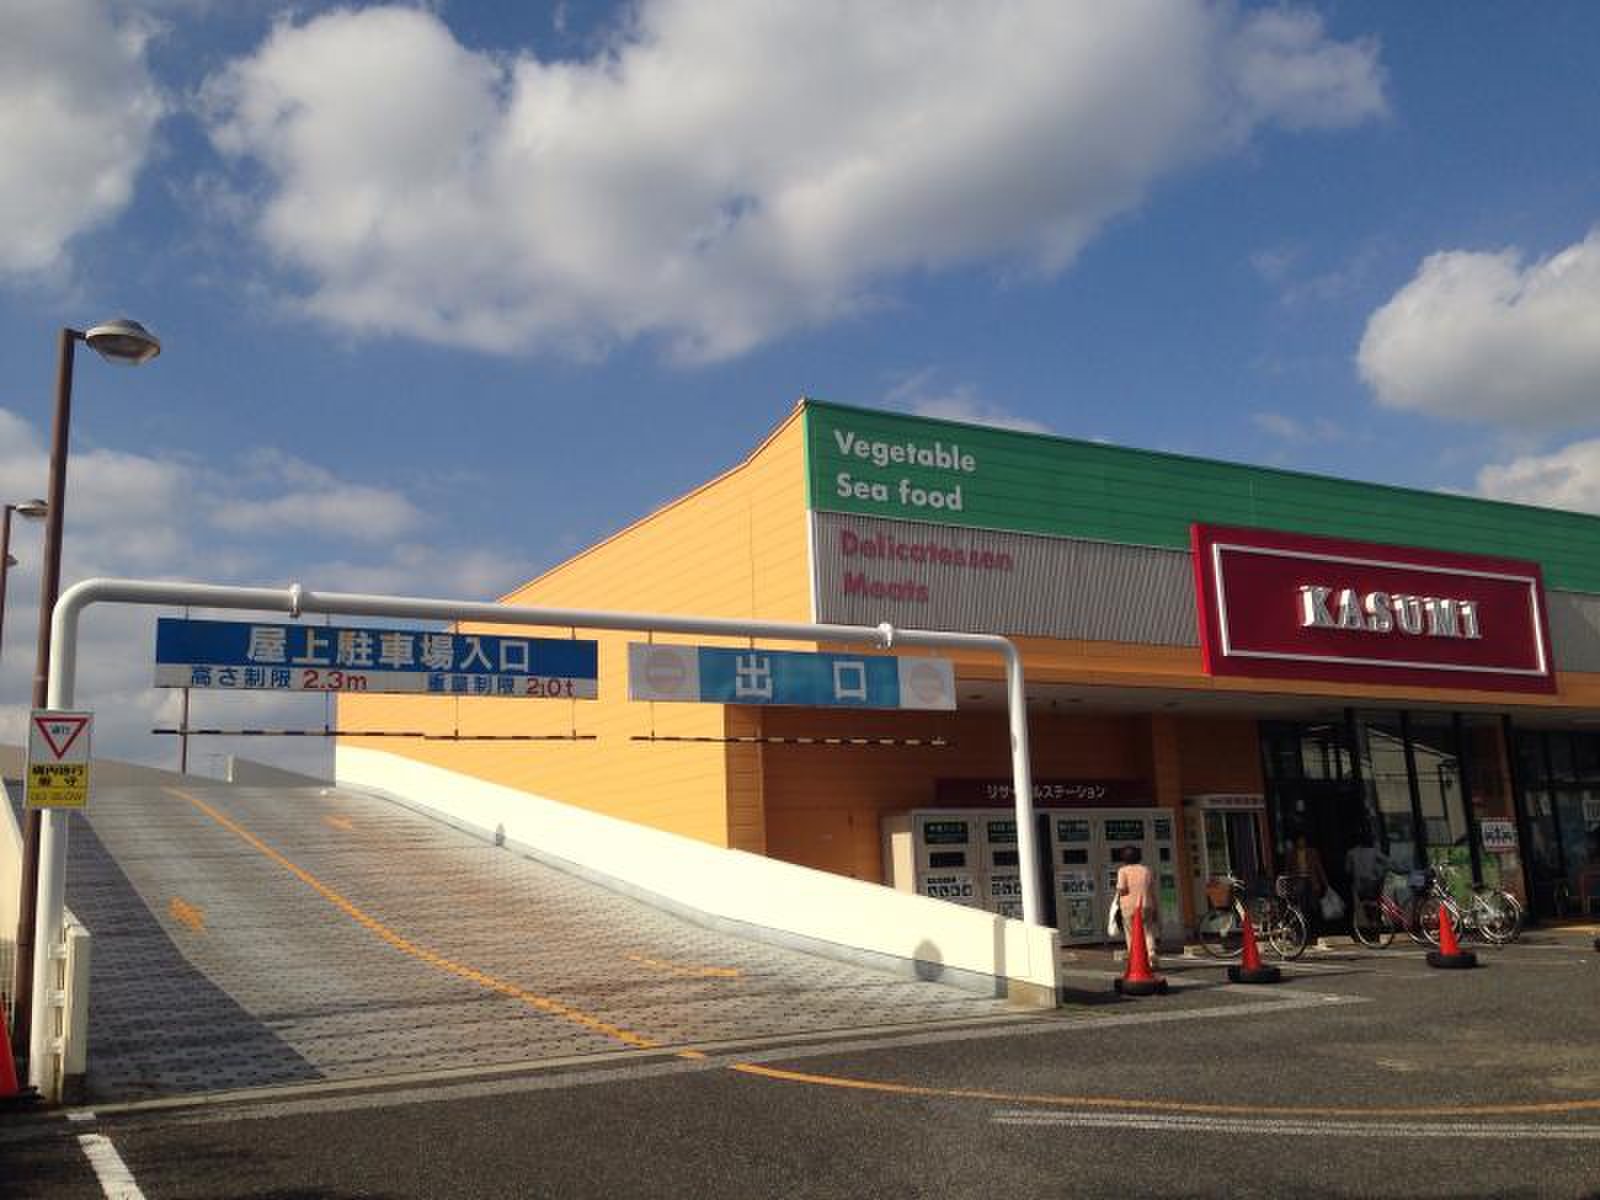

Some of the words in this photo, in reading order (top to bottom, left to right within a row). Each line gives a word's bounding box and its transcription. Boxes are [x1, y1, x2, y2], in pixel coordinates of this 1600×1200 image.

[833, 428, 977, 473] Vegetable
[836, 473, 888, 501] Sea
[899, 479, 963, 511] food
[840, 530, 1013, 572] Delicatessen
[843, 571, 929, 603] Meats
[1298, 585, 1482, 640] KASUMI
[247, 626, 532, 674] 屋上駐車場入口
[190, 666, 291, 689] 高さ制限
[303, 669, 368, 691] 2.3m
[735, 653, 868, 702] 出口
